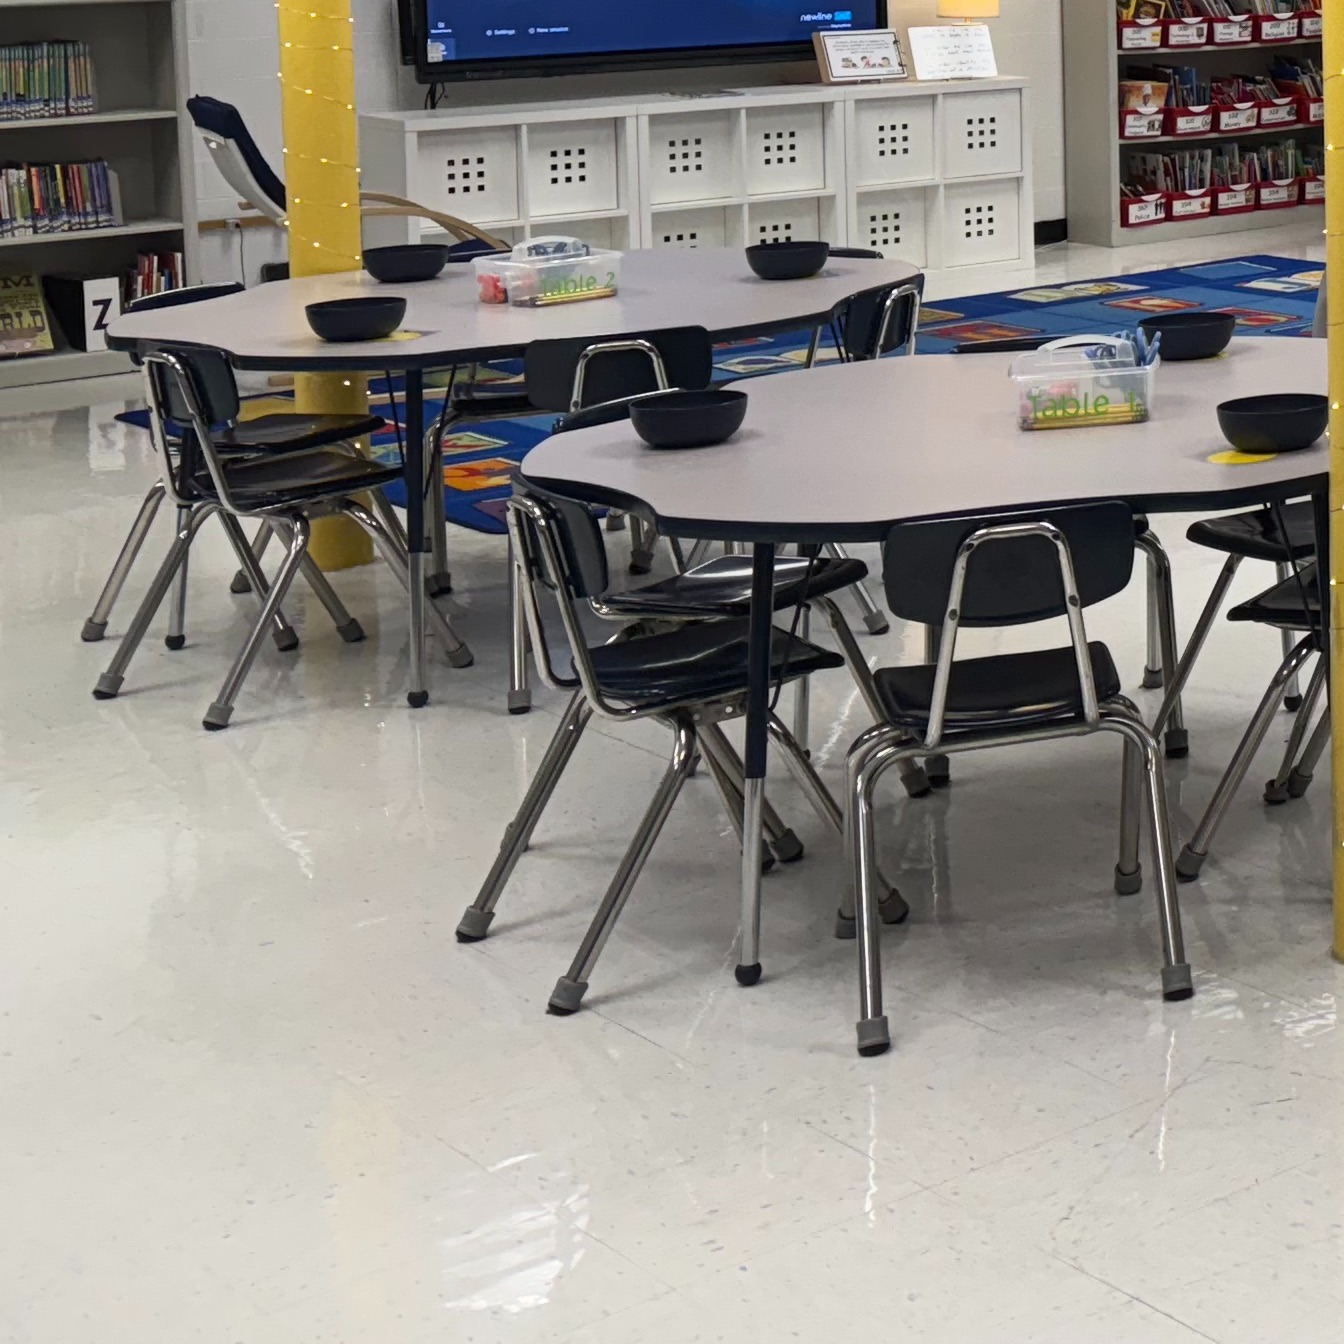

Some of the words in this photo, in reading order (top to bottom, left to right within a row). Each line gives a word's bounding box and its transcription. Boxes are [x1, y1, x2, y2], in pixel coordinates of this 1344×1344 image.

[605, 272, 615, 288] 2
[92, 298, 112, 331] Z
[1026, 392, 1109, 419] Table
